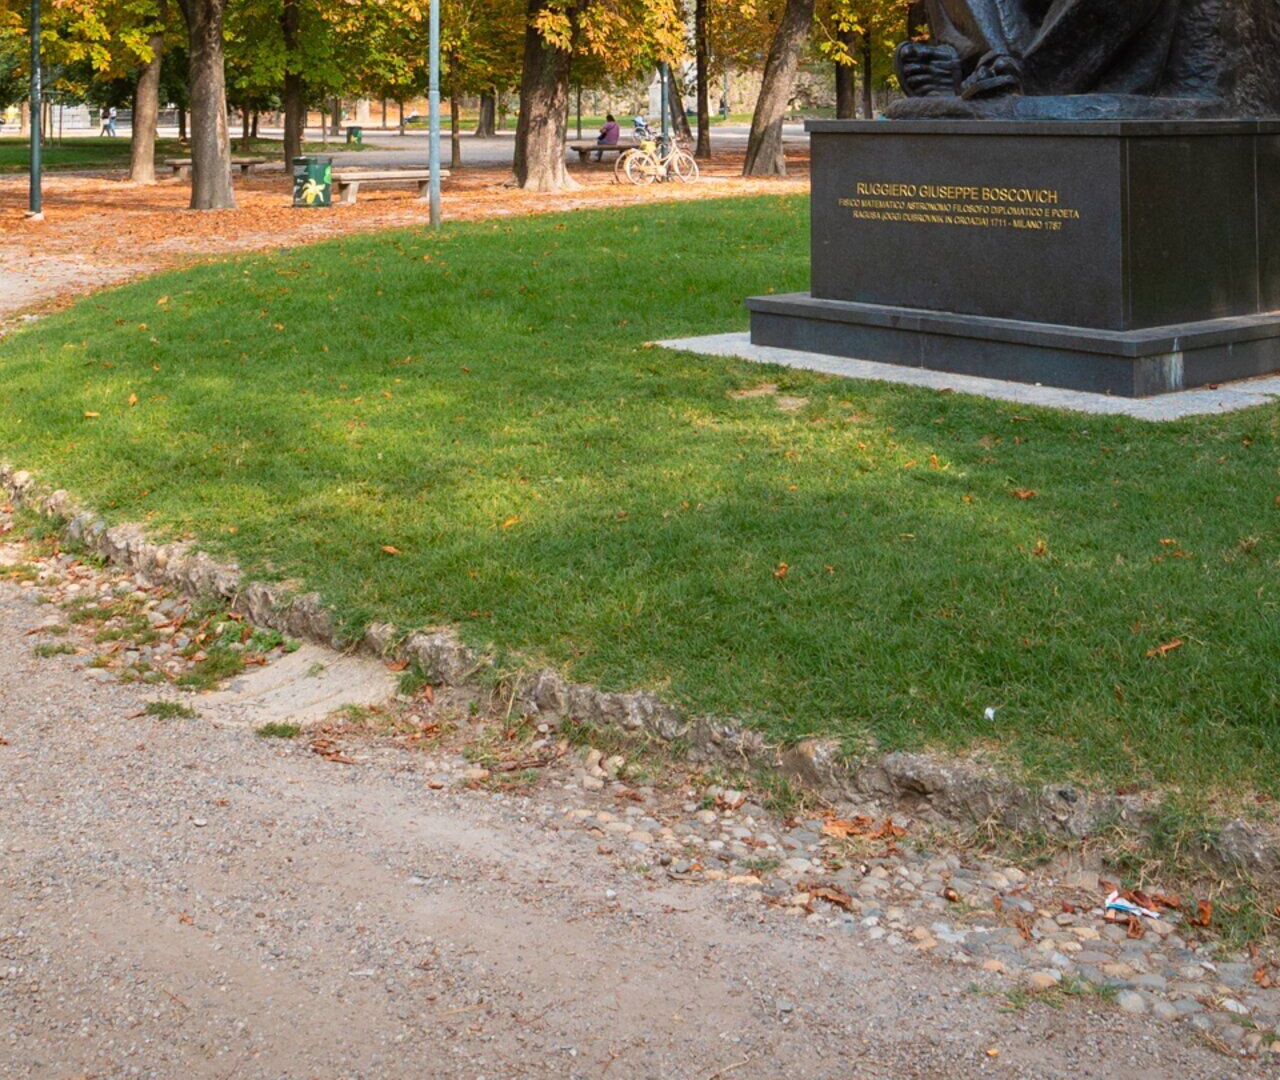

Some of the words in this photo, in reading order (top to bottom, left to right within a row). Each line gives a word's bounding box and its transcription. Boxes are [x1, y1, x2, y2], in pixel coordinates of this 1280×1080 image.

[857, 182, 916, 197] RUGGIERO
[919, 185, 979, 200] GIUSEPPE
[982, 187, 1058, 203] BOSCOVICH
[953, 204, 989, 213] FILOSOFO
[991, 206, 1042, 216] DIPLOMATICO
[1051, 209, 1080, 218] POETA
[1013, 219, 1042, 229] MILANO
